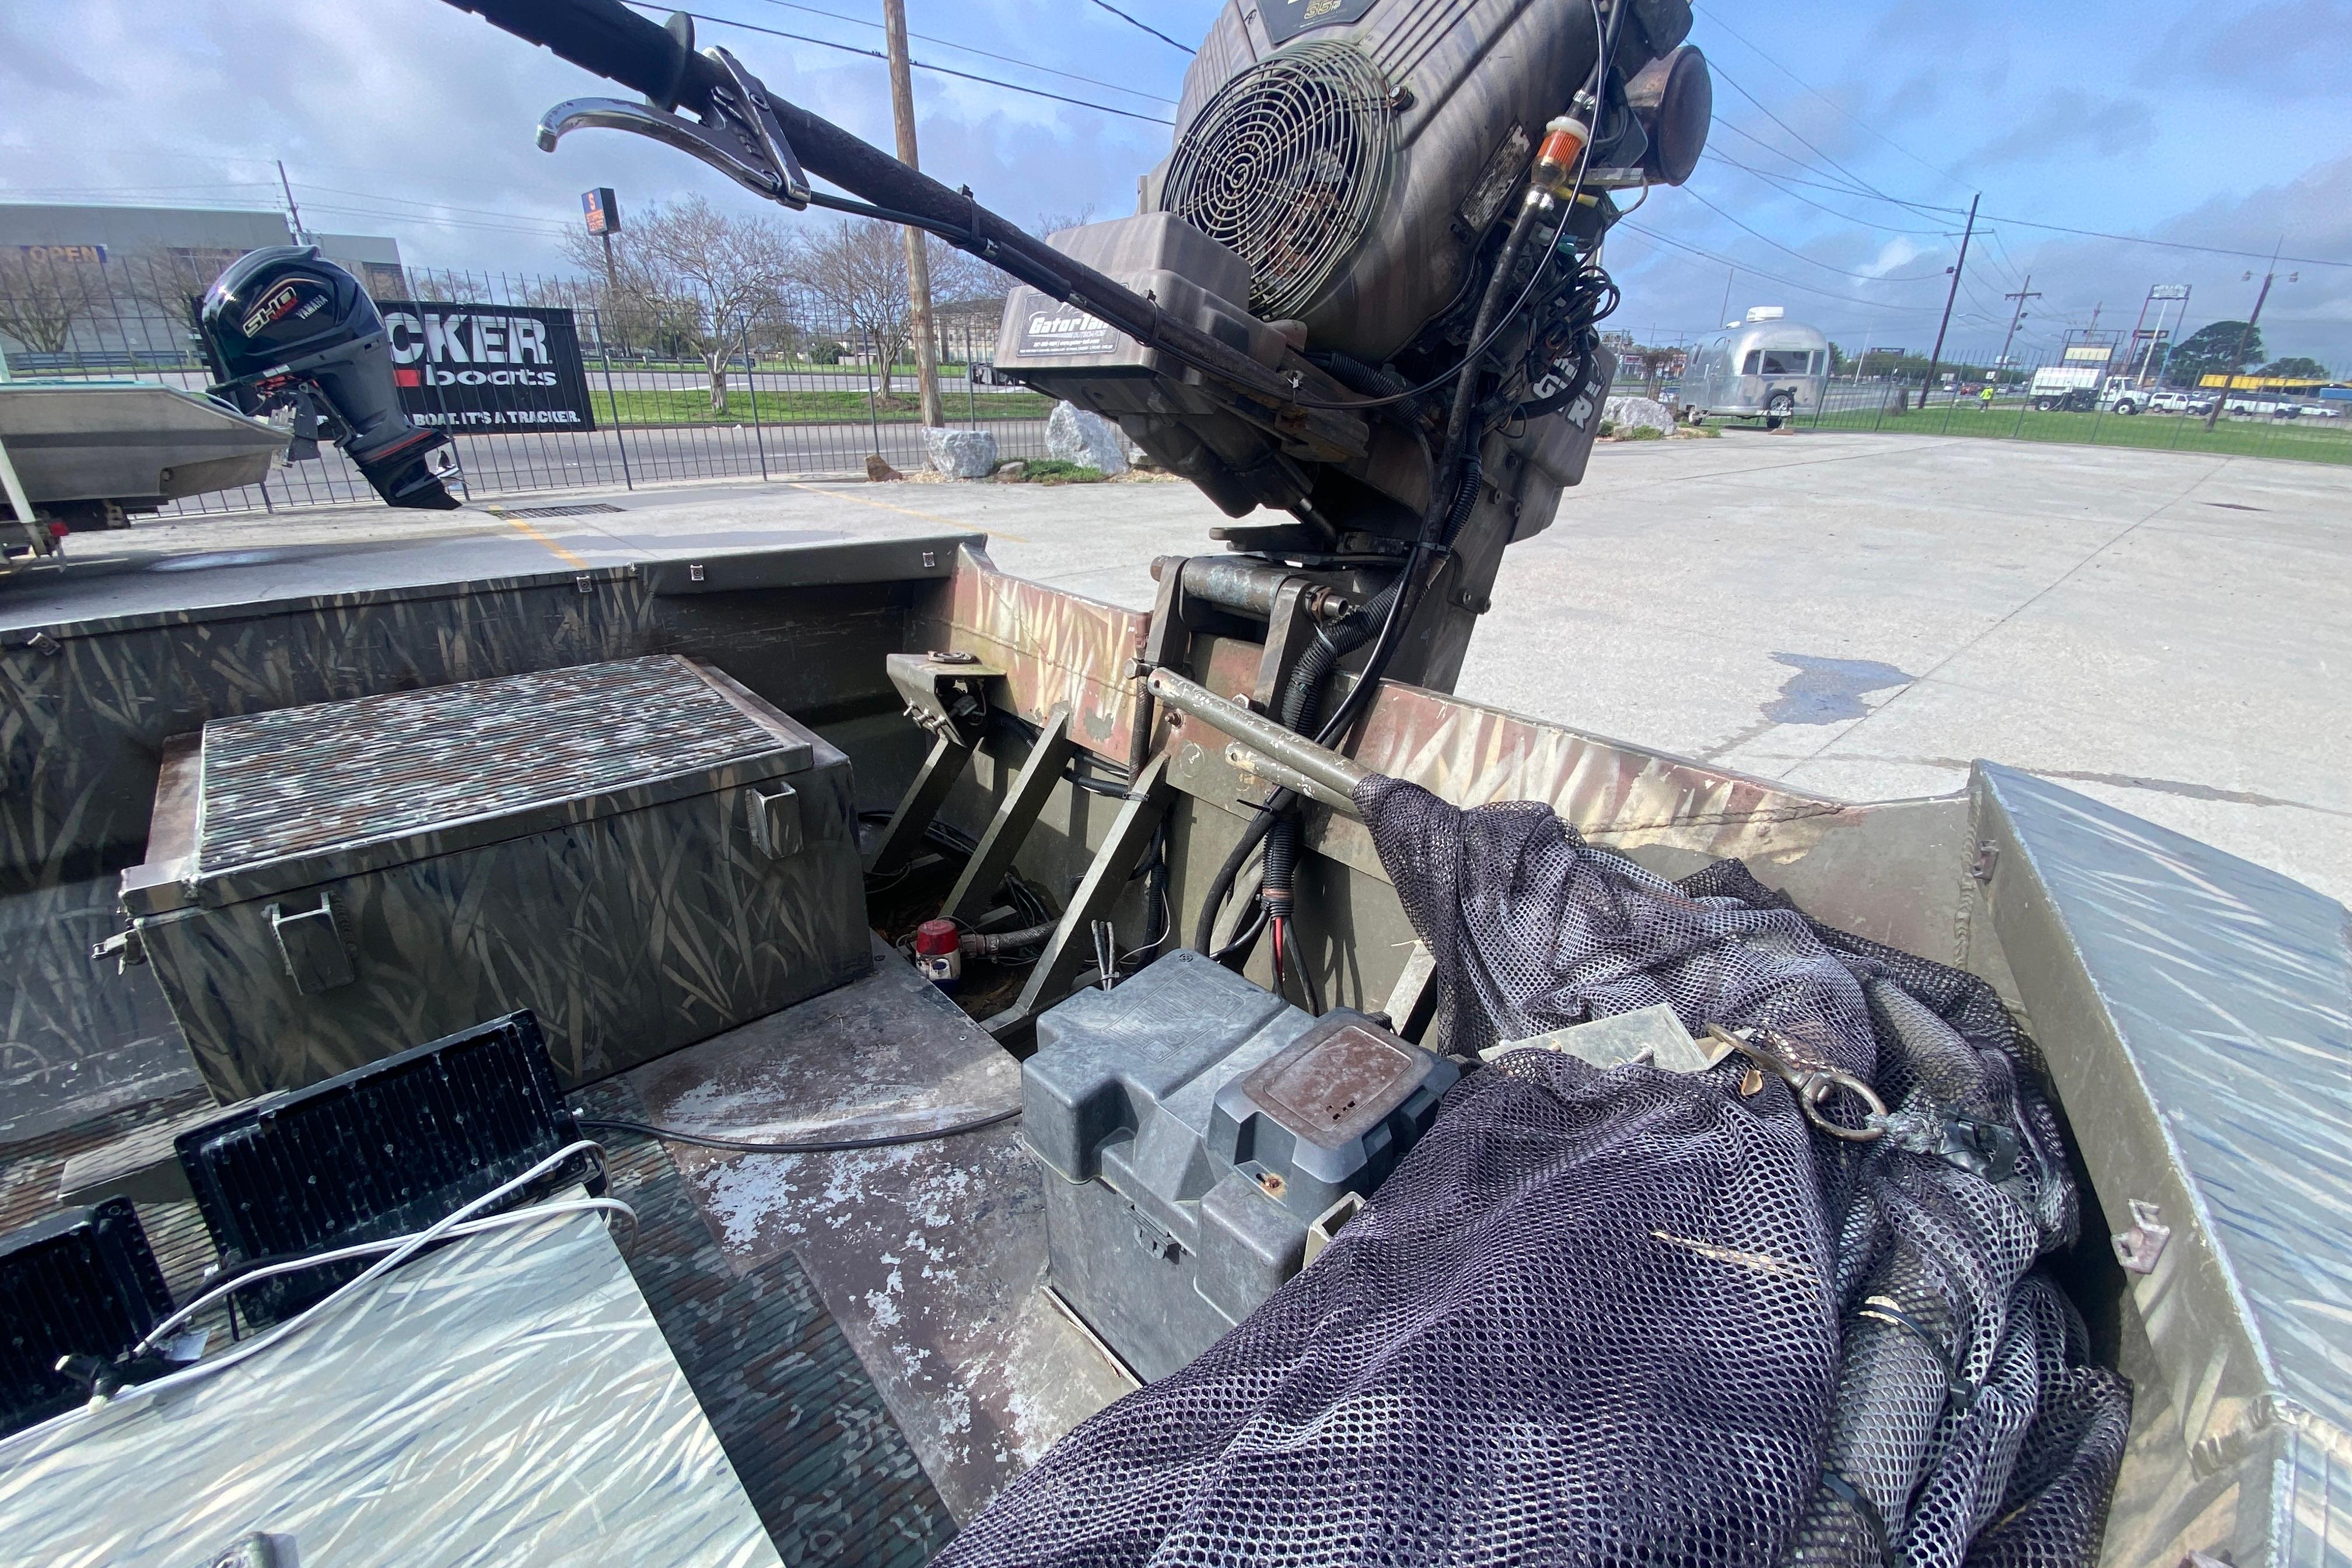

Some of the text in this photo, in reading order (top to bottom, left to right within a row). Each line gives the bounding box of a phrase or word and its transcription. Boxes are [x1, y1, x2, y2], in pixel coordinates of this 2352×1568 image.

[1304, 1, 1333, 19] 35
[29, 245, 100, 264] OPEN
[295, 294, 329, 320] YAMAHA
[384, 312, 549, 365] CKER
[426, 364, 557, 386] boats
[412, 413, 460, 426] BOAT.
[461, 412, 492, 425] IT'S
[495, 411, 506, 424] A
[506, 411, 581, 424] TRACKER.
